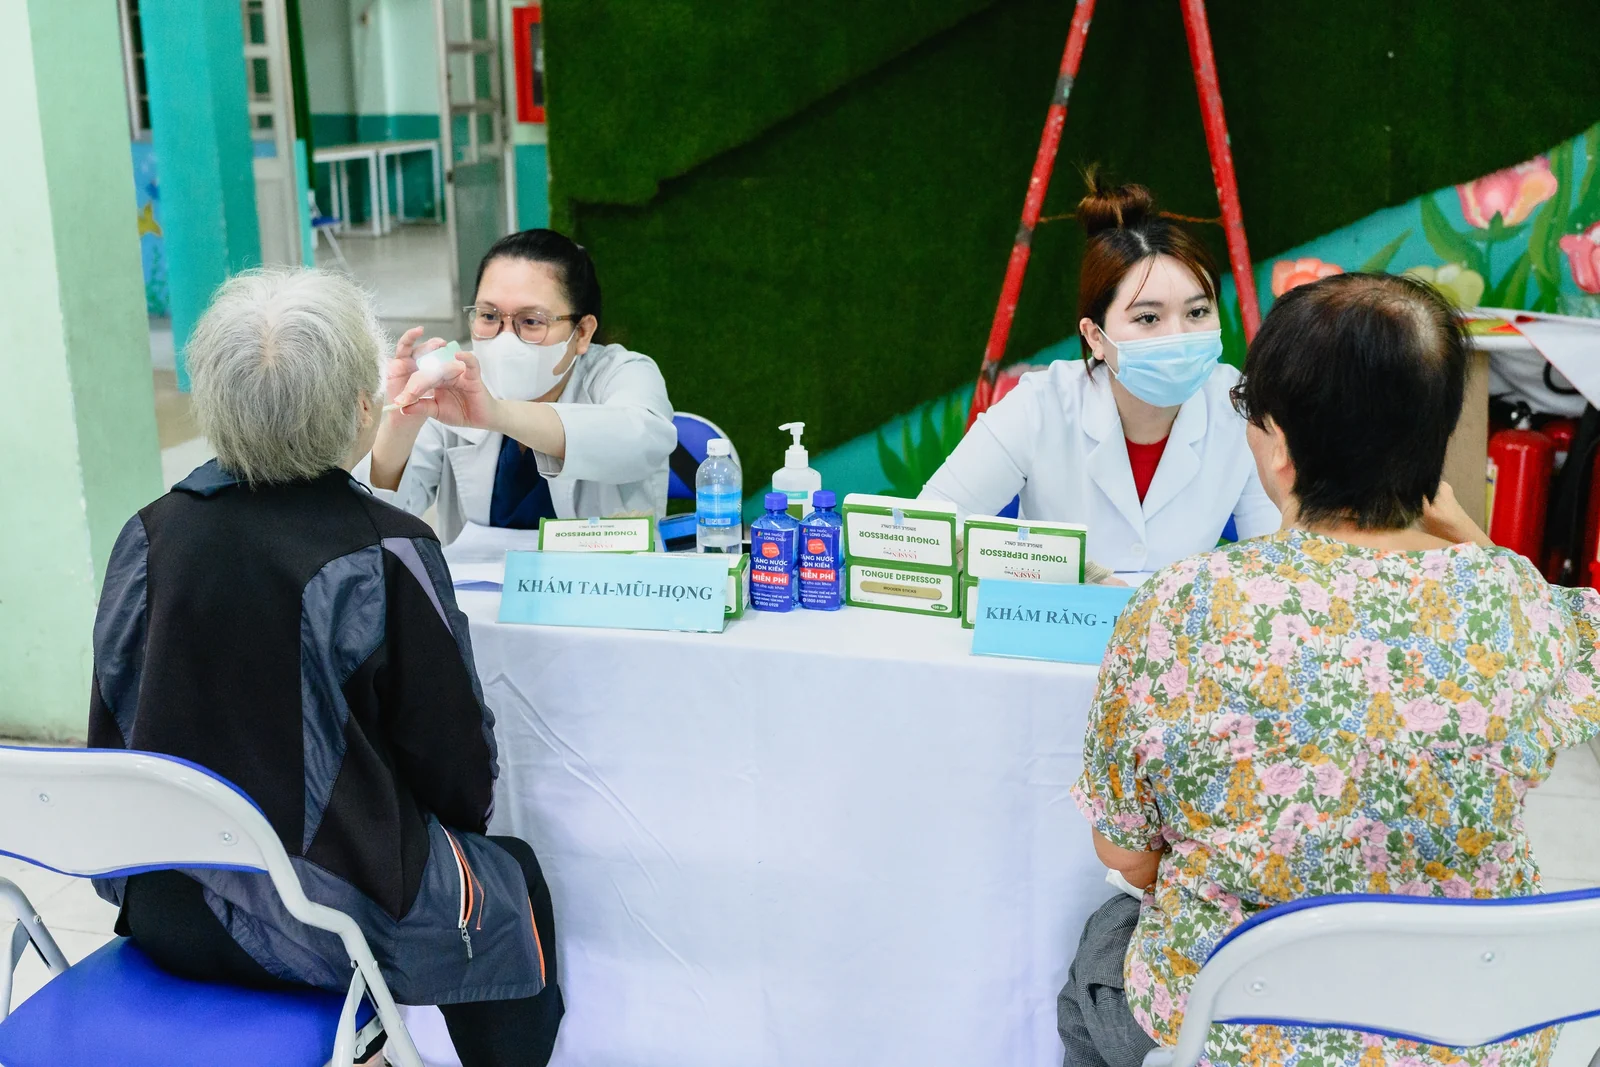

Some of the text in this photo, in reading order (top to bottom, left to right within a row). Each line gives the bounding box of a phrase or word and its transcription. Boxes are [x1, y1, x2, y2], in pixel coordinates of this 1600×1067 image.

[859, 531, 940, 546] TONGUE DEPRESSOR
[980, 548, 1067, 563] TONGUE DEPRESSOR
[774, 575, 787, 584] PHÍ
[819, 572, 834, 580] PHÍ
[861, 570, 941, 584] TONGUE DEPRESSOR
[517, 576, 713, 602] KHÁM TAI-MŨI-HỌNG
[986, 605, 1041, 622] KHÁM
[1046, 608, 1097, 626] RĂNG
